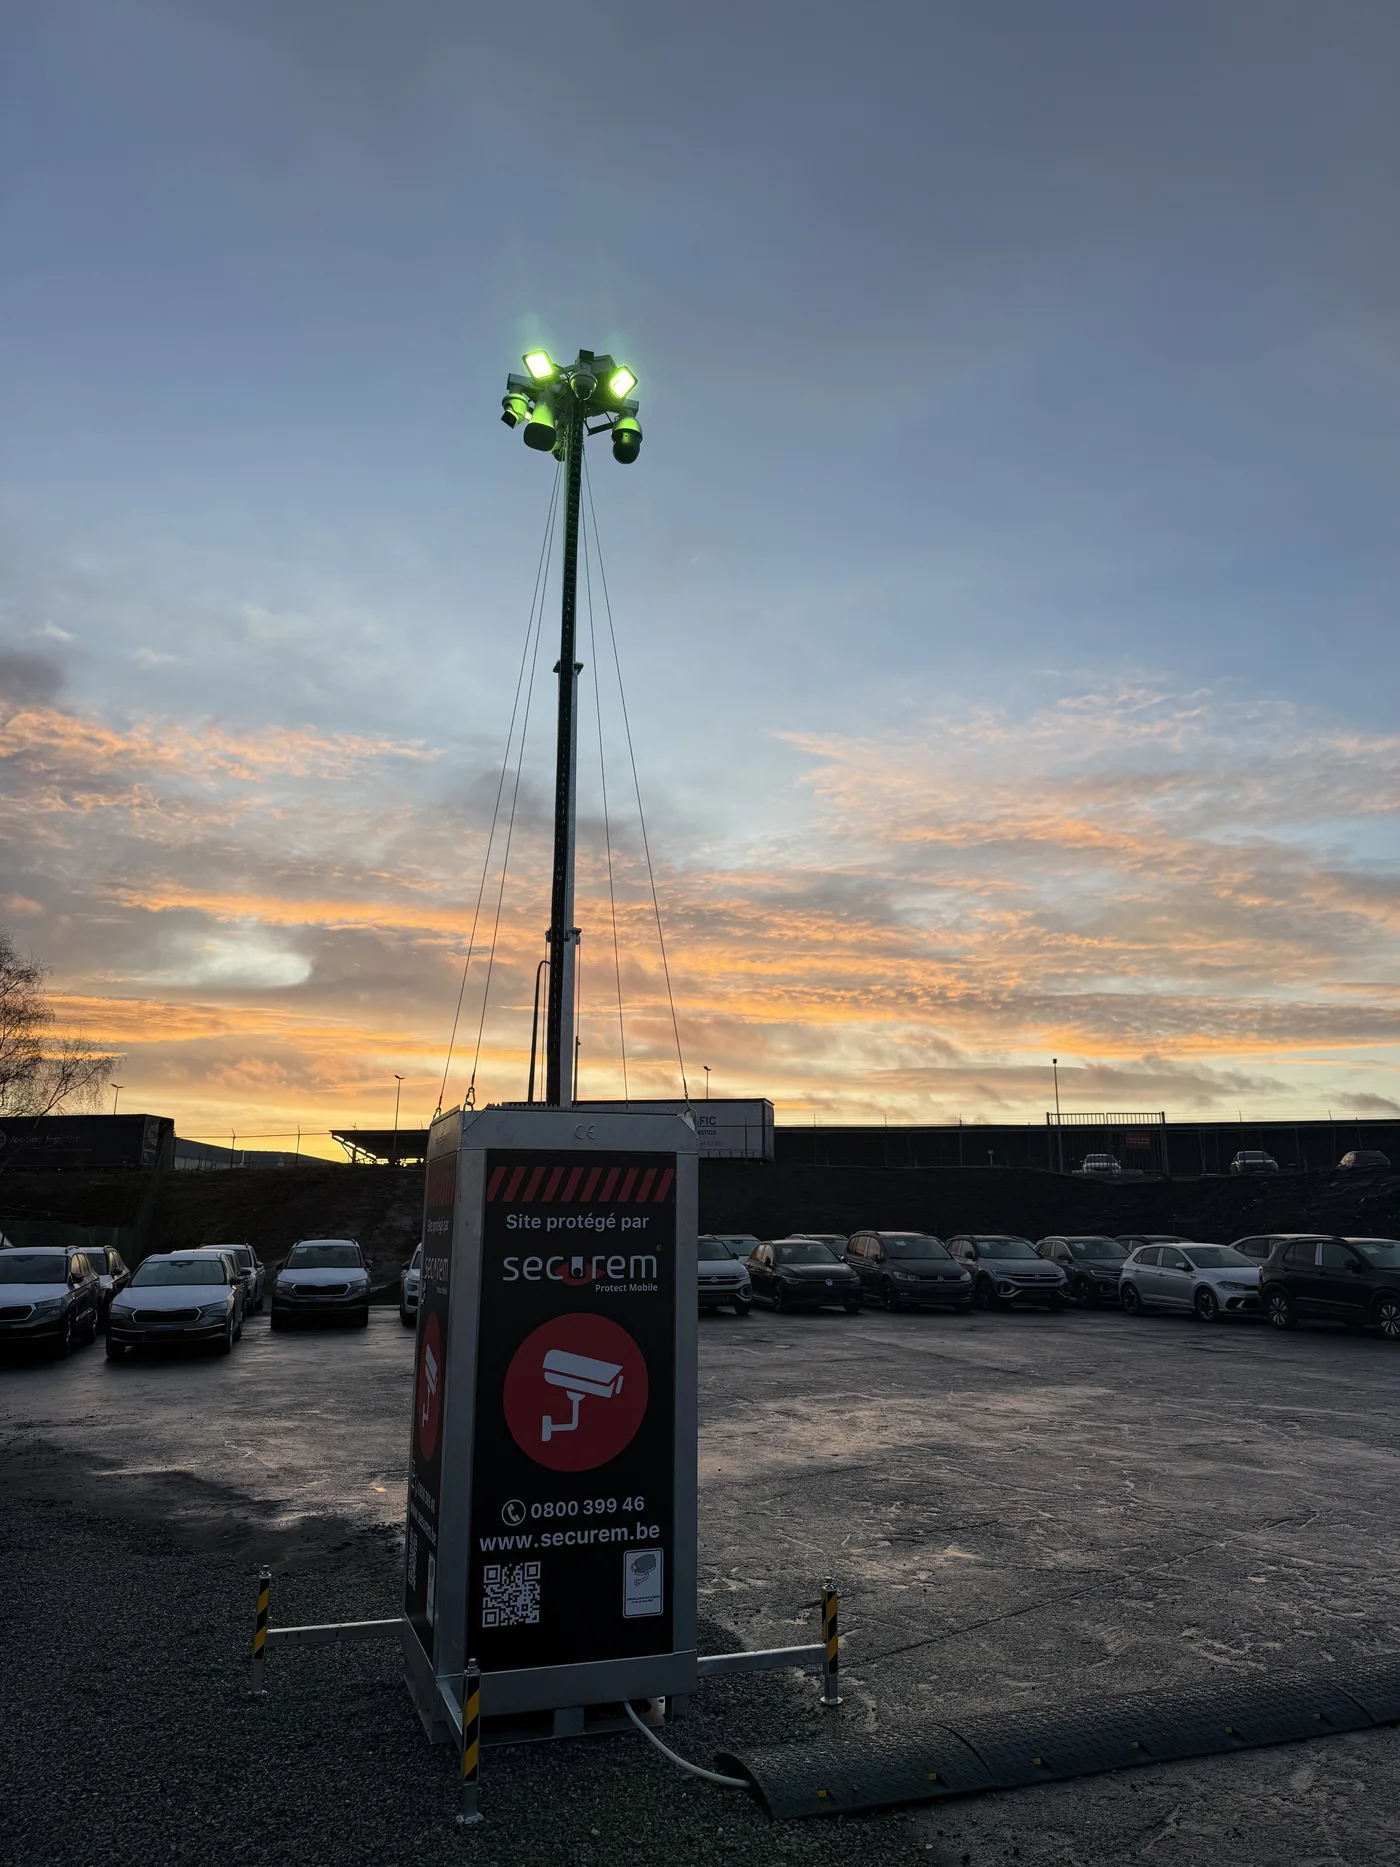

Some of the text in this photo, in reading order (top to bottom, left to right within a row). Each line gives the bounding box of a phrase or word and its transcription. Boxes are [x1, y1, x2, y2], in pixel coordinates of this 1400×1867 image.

[505, 1212, 650, 1231] Site protégé par
[595, 1283, 658, 1293] Protect Mobile
[530, 1496, 645, 1519] 0800 399 46
[479, 1521, 661, 1552] www.securem.be
